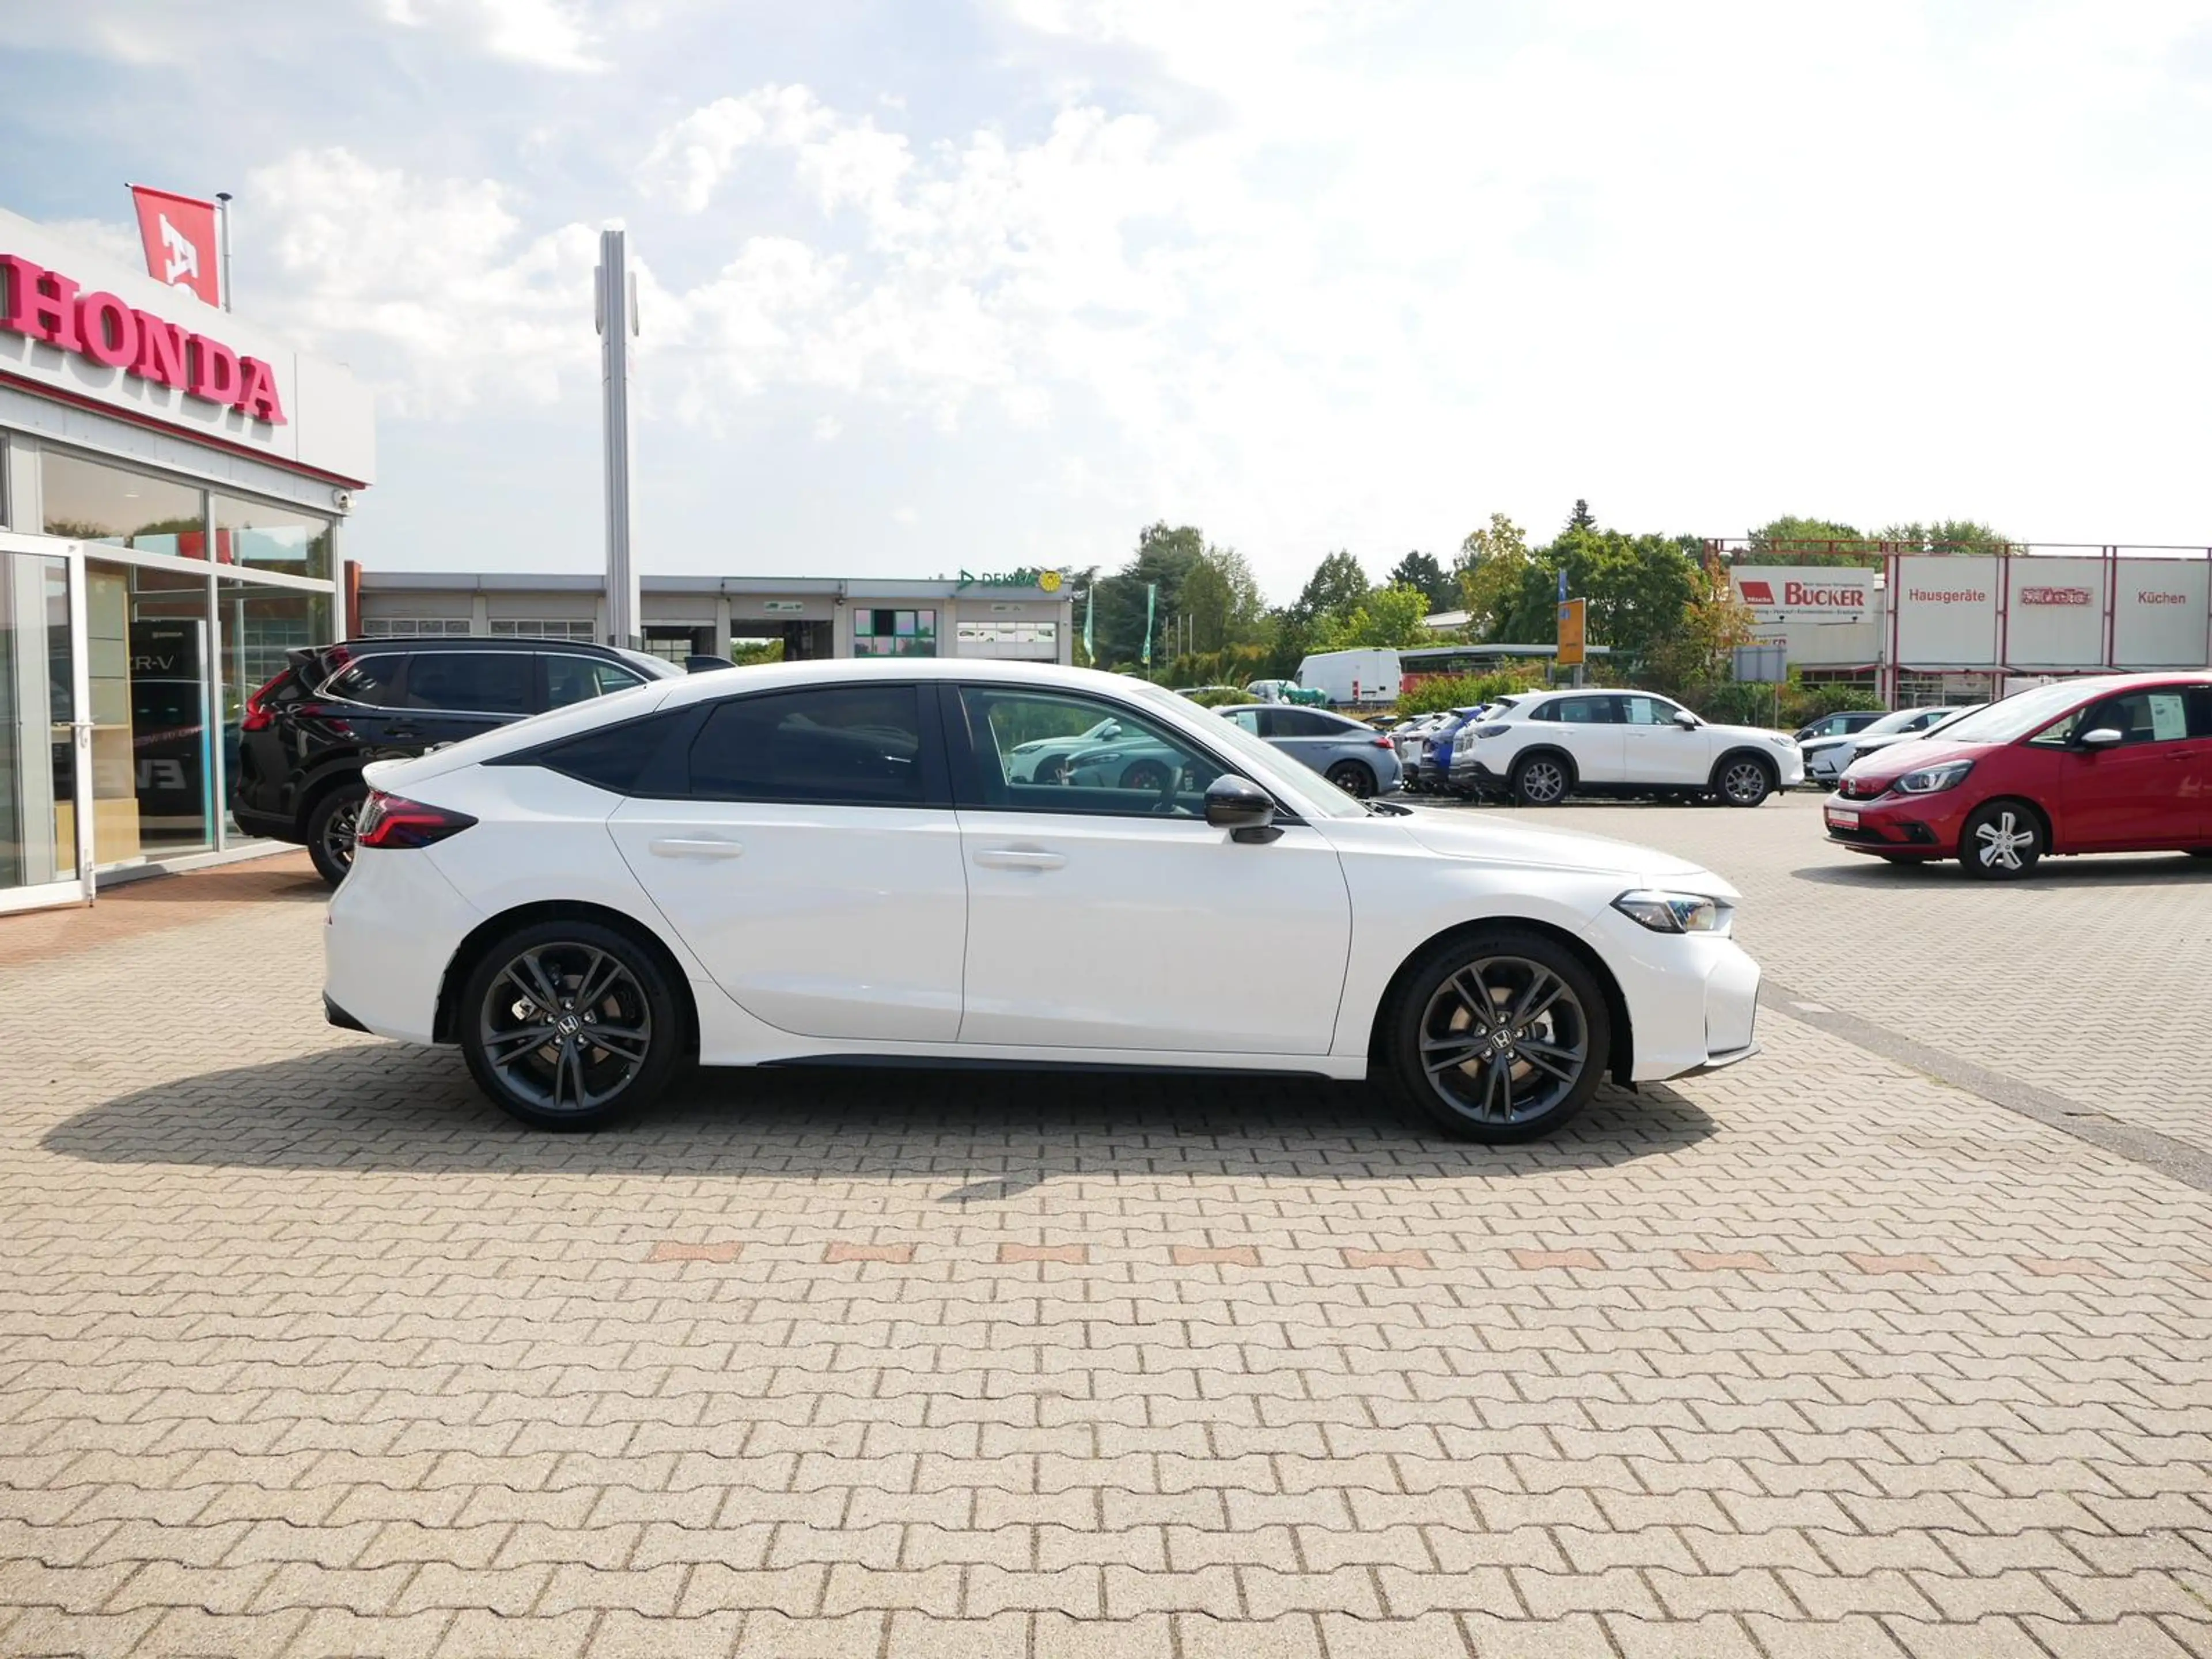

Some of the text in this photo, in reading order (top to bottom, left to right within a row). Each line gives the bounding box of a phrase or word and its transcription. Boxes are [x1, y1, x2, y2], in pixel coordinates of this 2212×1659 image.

[0, 254, 288, 426] HONDA
[1908, 589, 1986, 604] Hausgeräte
[2138, 592, 2186, 604] Küchen
[131, 655, 174, 671] R-V
